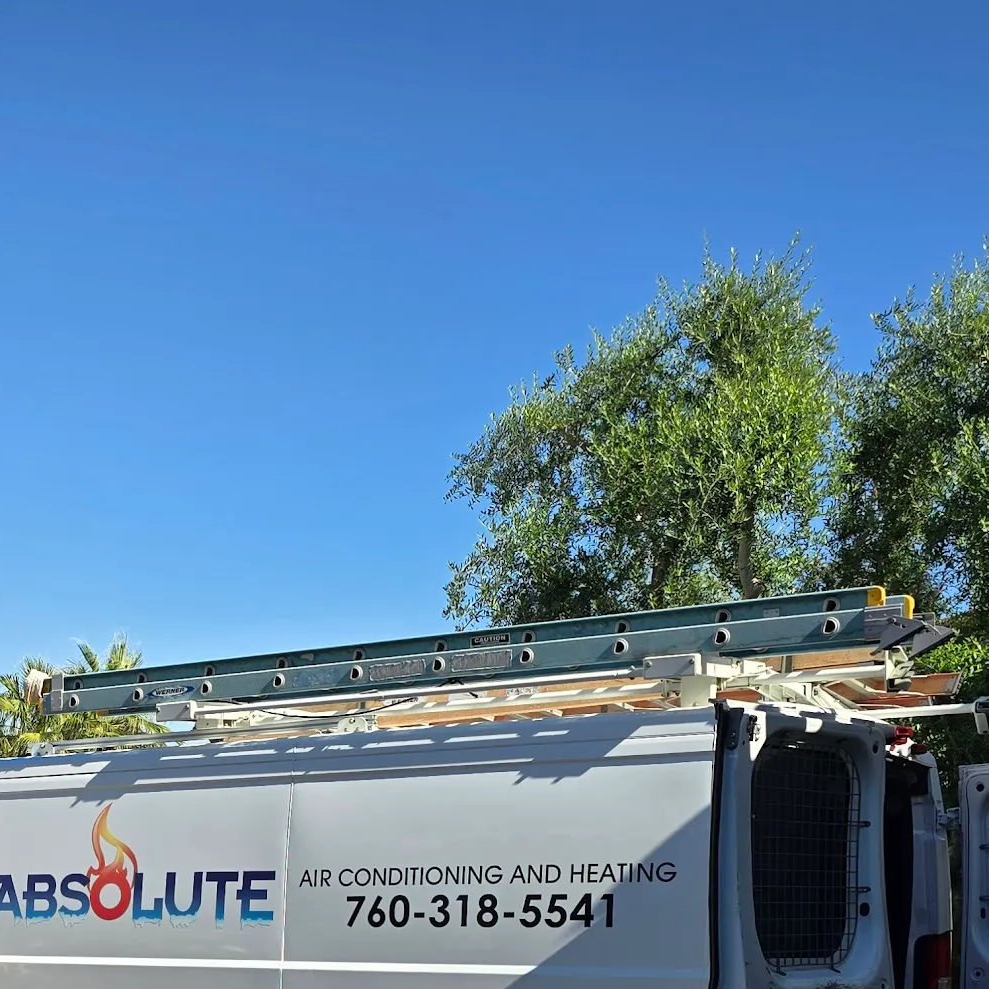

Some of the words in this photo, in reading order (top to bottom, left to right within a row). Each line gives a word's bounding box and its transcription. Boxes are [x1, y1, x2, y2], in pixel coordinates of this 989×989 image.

[474, 635, 506, 644] CAUTION
[155, 687, 185, 696] WERNER
[299, 868, 332, 888] AIR
[337, 864, 504, 888] CONDITIONING
[510, 863, 562, 885] AND
[569, 861, 678, 884] HEATING
[345, 892, 615, 929] 760-318-5541
